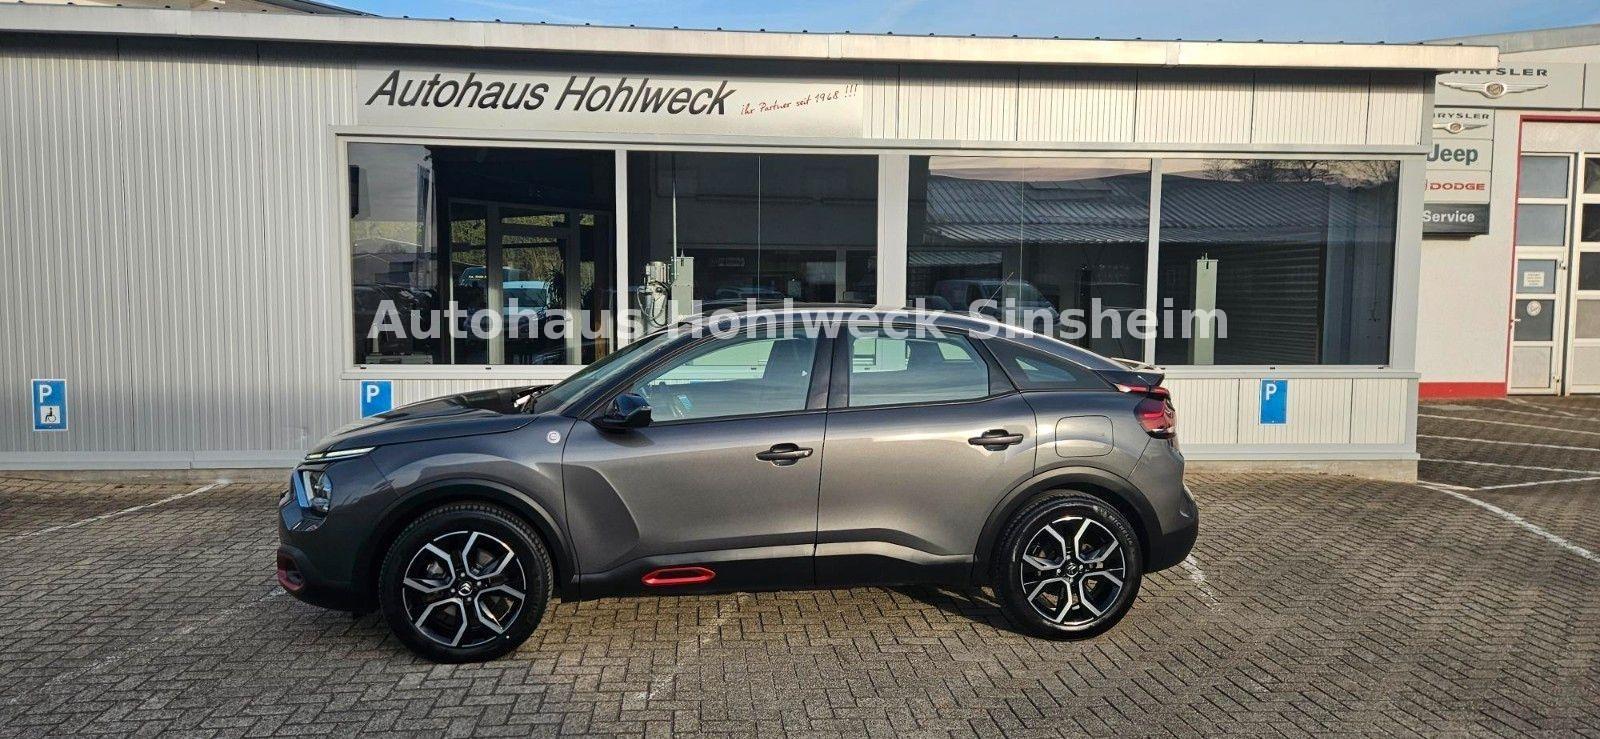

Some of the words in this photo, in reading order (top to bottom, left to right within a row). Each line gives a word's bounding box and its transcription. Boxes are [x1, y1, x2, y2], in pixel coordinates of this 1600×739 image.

[365, 70, 548, 110] Autohaus
[554, 75, 736, 115] Hohlweck
[759, 99, 792, 112] Partner
[796, 94, 811, 107] seit
[814, 90, 840, 103] 1968
[1433, 112, 1490, 120] RYSLER
[1427, 143, 1479, 166] Jeep
[1430, 182, 1486, 191] DODGE
[1422, 209, 1476, 223] Service
[39, 384, 53, 403] P
[366, 384, 380, 403] P
[1265, 383, 1277, 401] P
